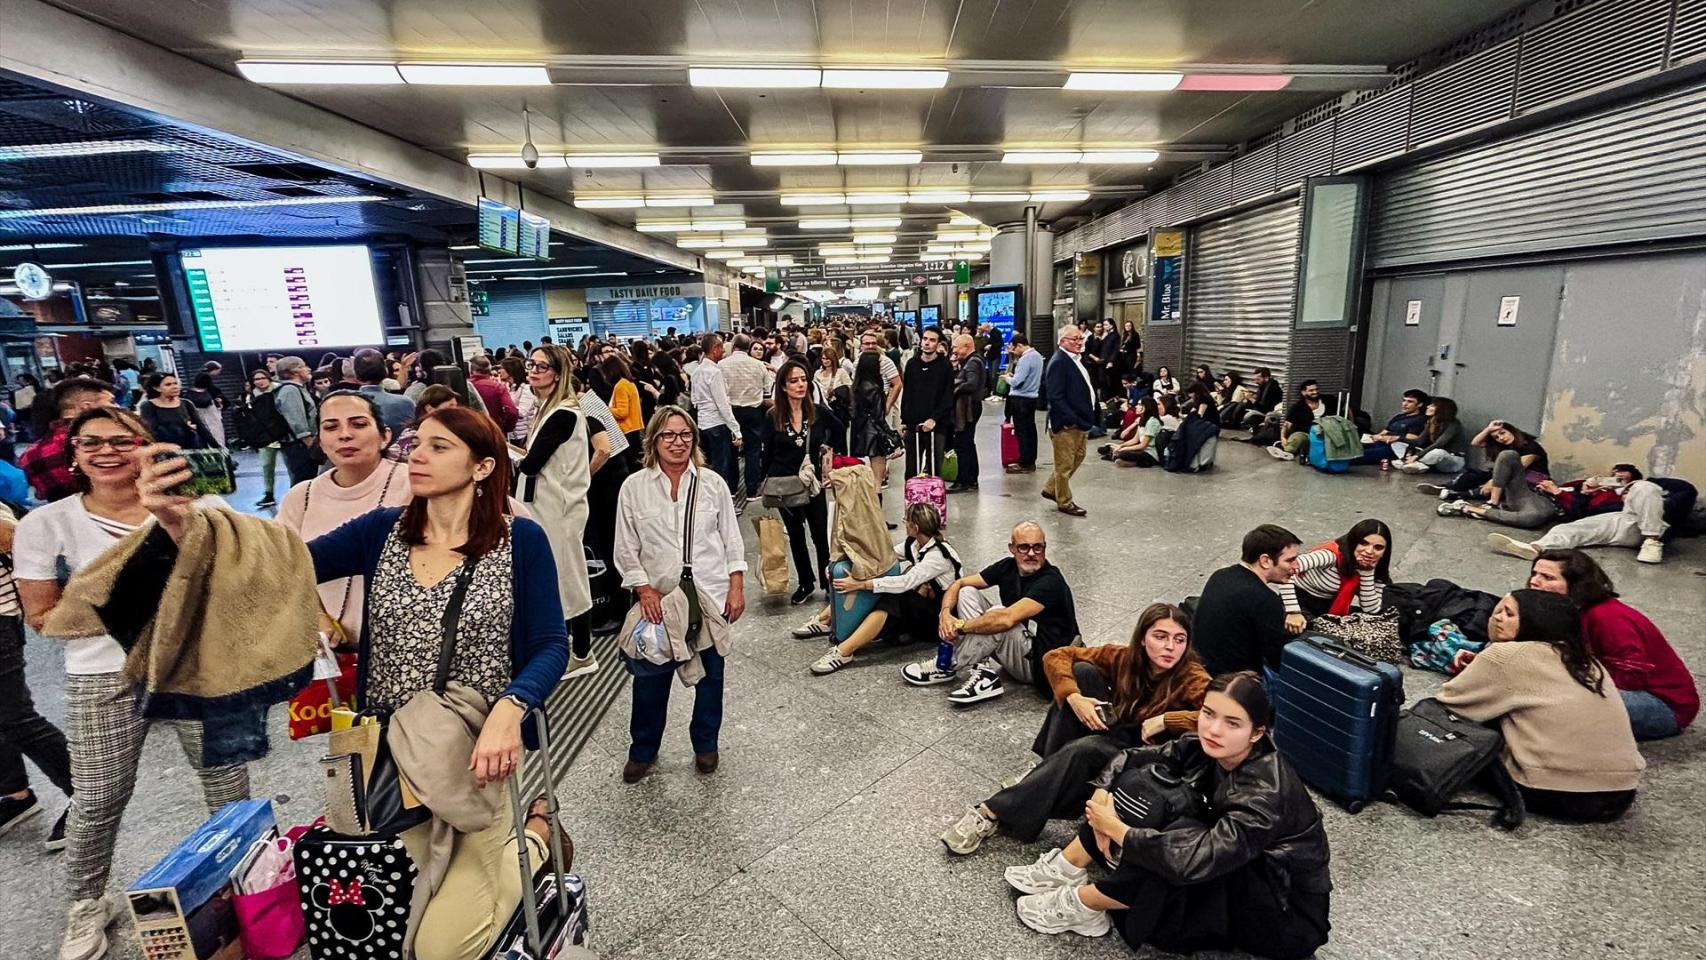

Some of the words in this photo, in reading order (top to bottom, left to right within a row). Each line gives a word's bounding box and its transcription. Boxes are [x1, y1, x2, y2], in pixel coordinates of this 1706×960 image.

[924, 261, 945, 271] 1:12
[609, 287, 634, 299] TASTY
[635, 286, 659, 298] DAILY
[660, 285, 681, 297] FOOD
[1161, 283, 1172, 303] Blue
[1160, 303, 1171, 320] Mr.
